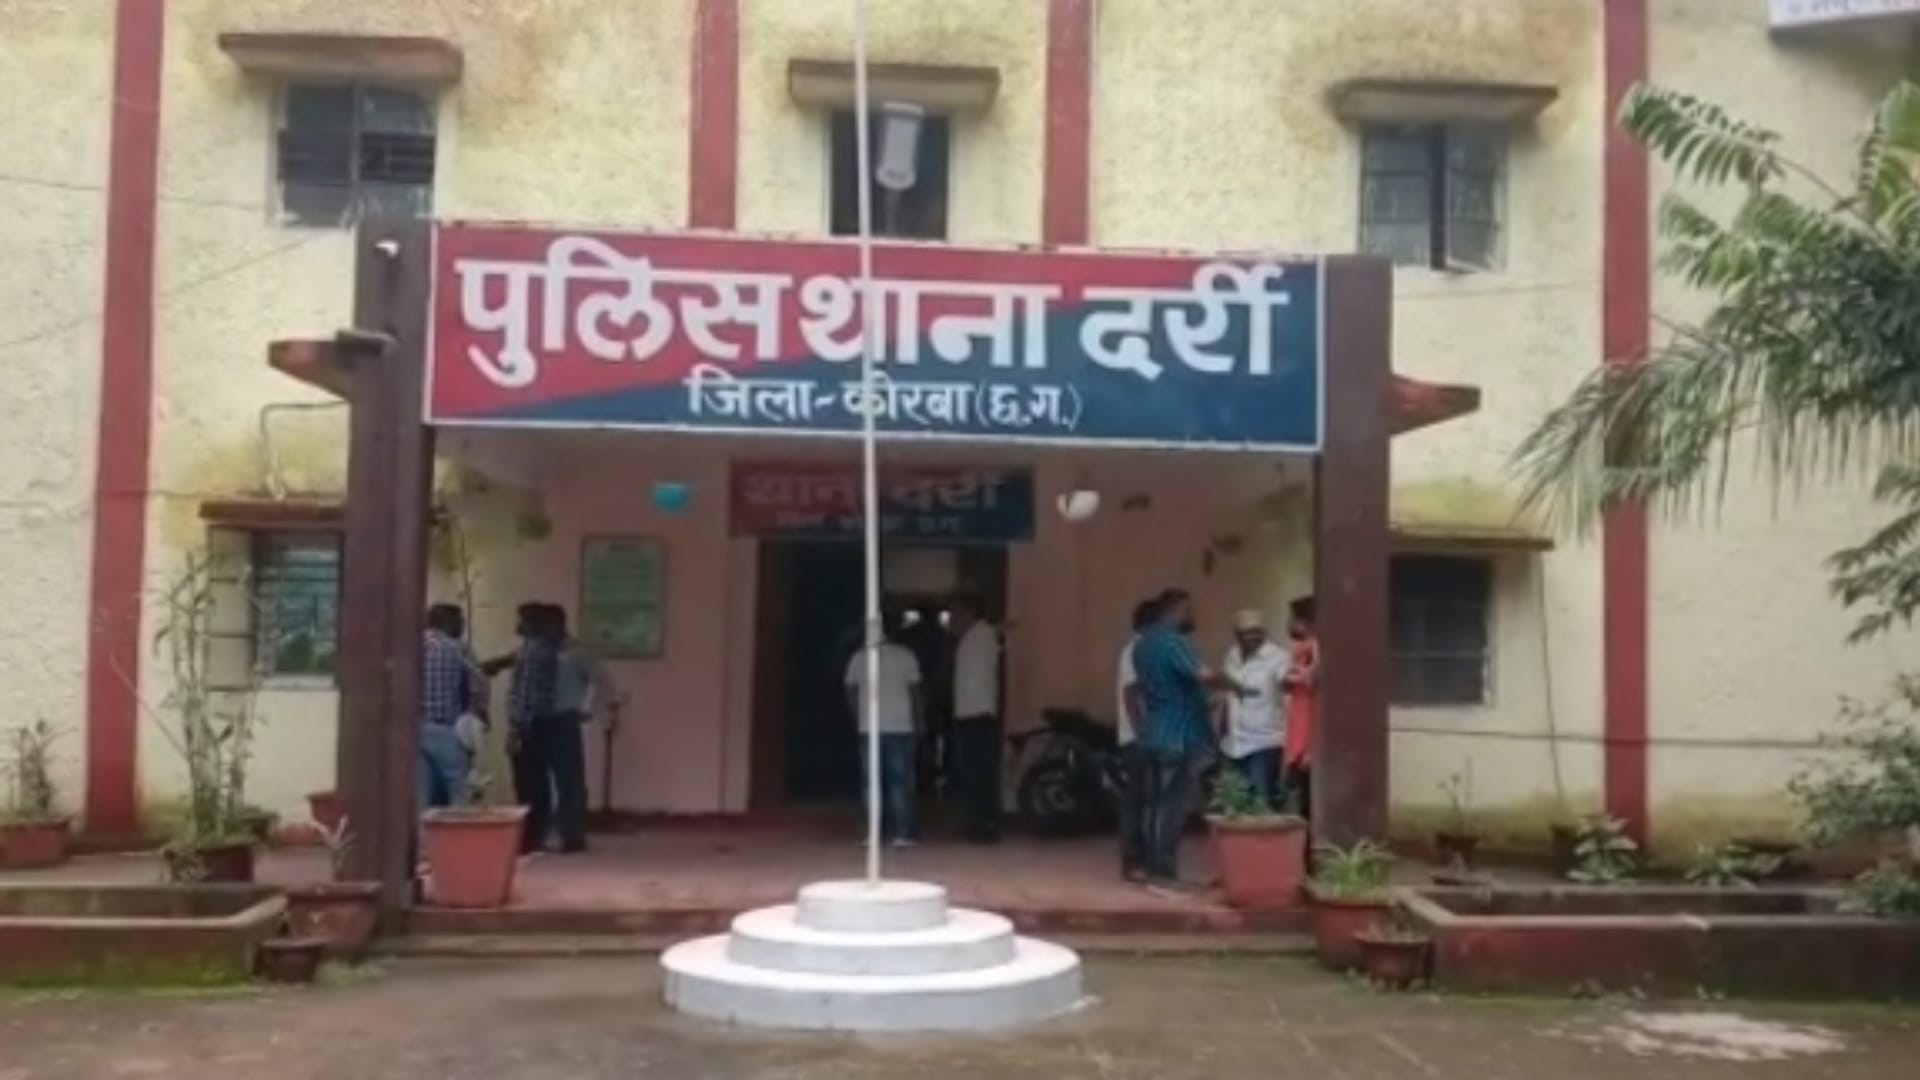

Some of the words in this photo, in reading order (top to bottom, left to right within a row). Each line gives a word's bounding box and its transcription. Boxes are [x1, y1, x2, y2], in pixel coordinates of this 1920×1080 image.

[454, 236, 793, 388] पुलिस
[800, 273, 1062, 370] थाना
[1079, 262, 1290, 381] दर्री
